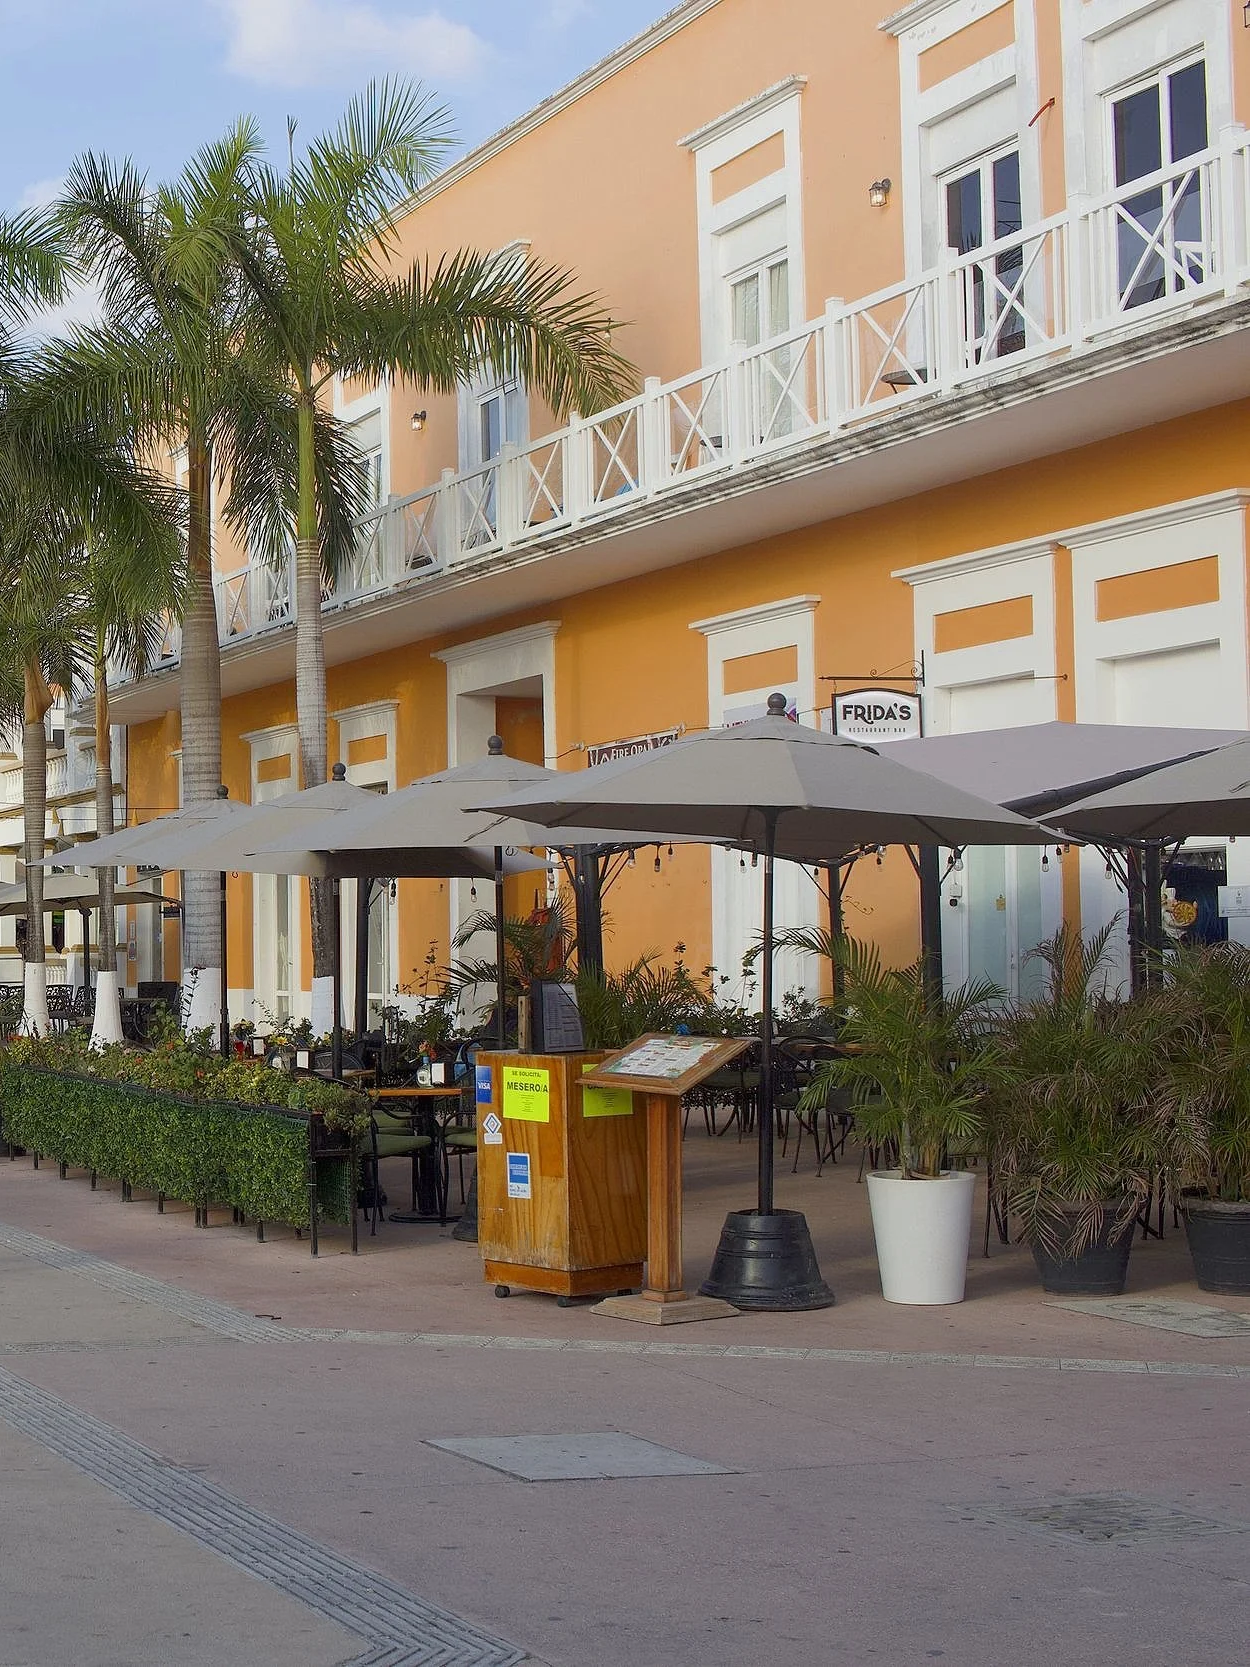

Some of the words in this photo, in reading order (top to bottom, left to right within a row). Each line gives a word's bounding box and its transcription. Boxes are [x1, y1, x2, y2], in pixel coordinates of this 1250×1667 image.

[842, 703, 911, 724] FRIDA'S
[611, 747, 629, 760] FIRE
[477, 1081, 491, 1090] VISA
